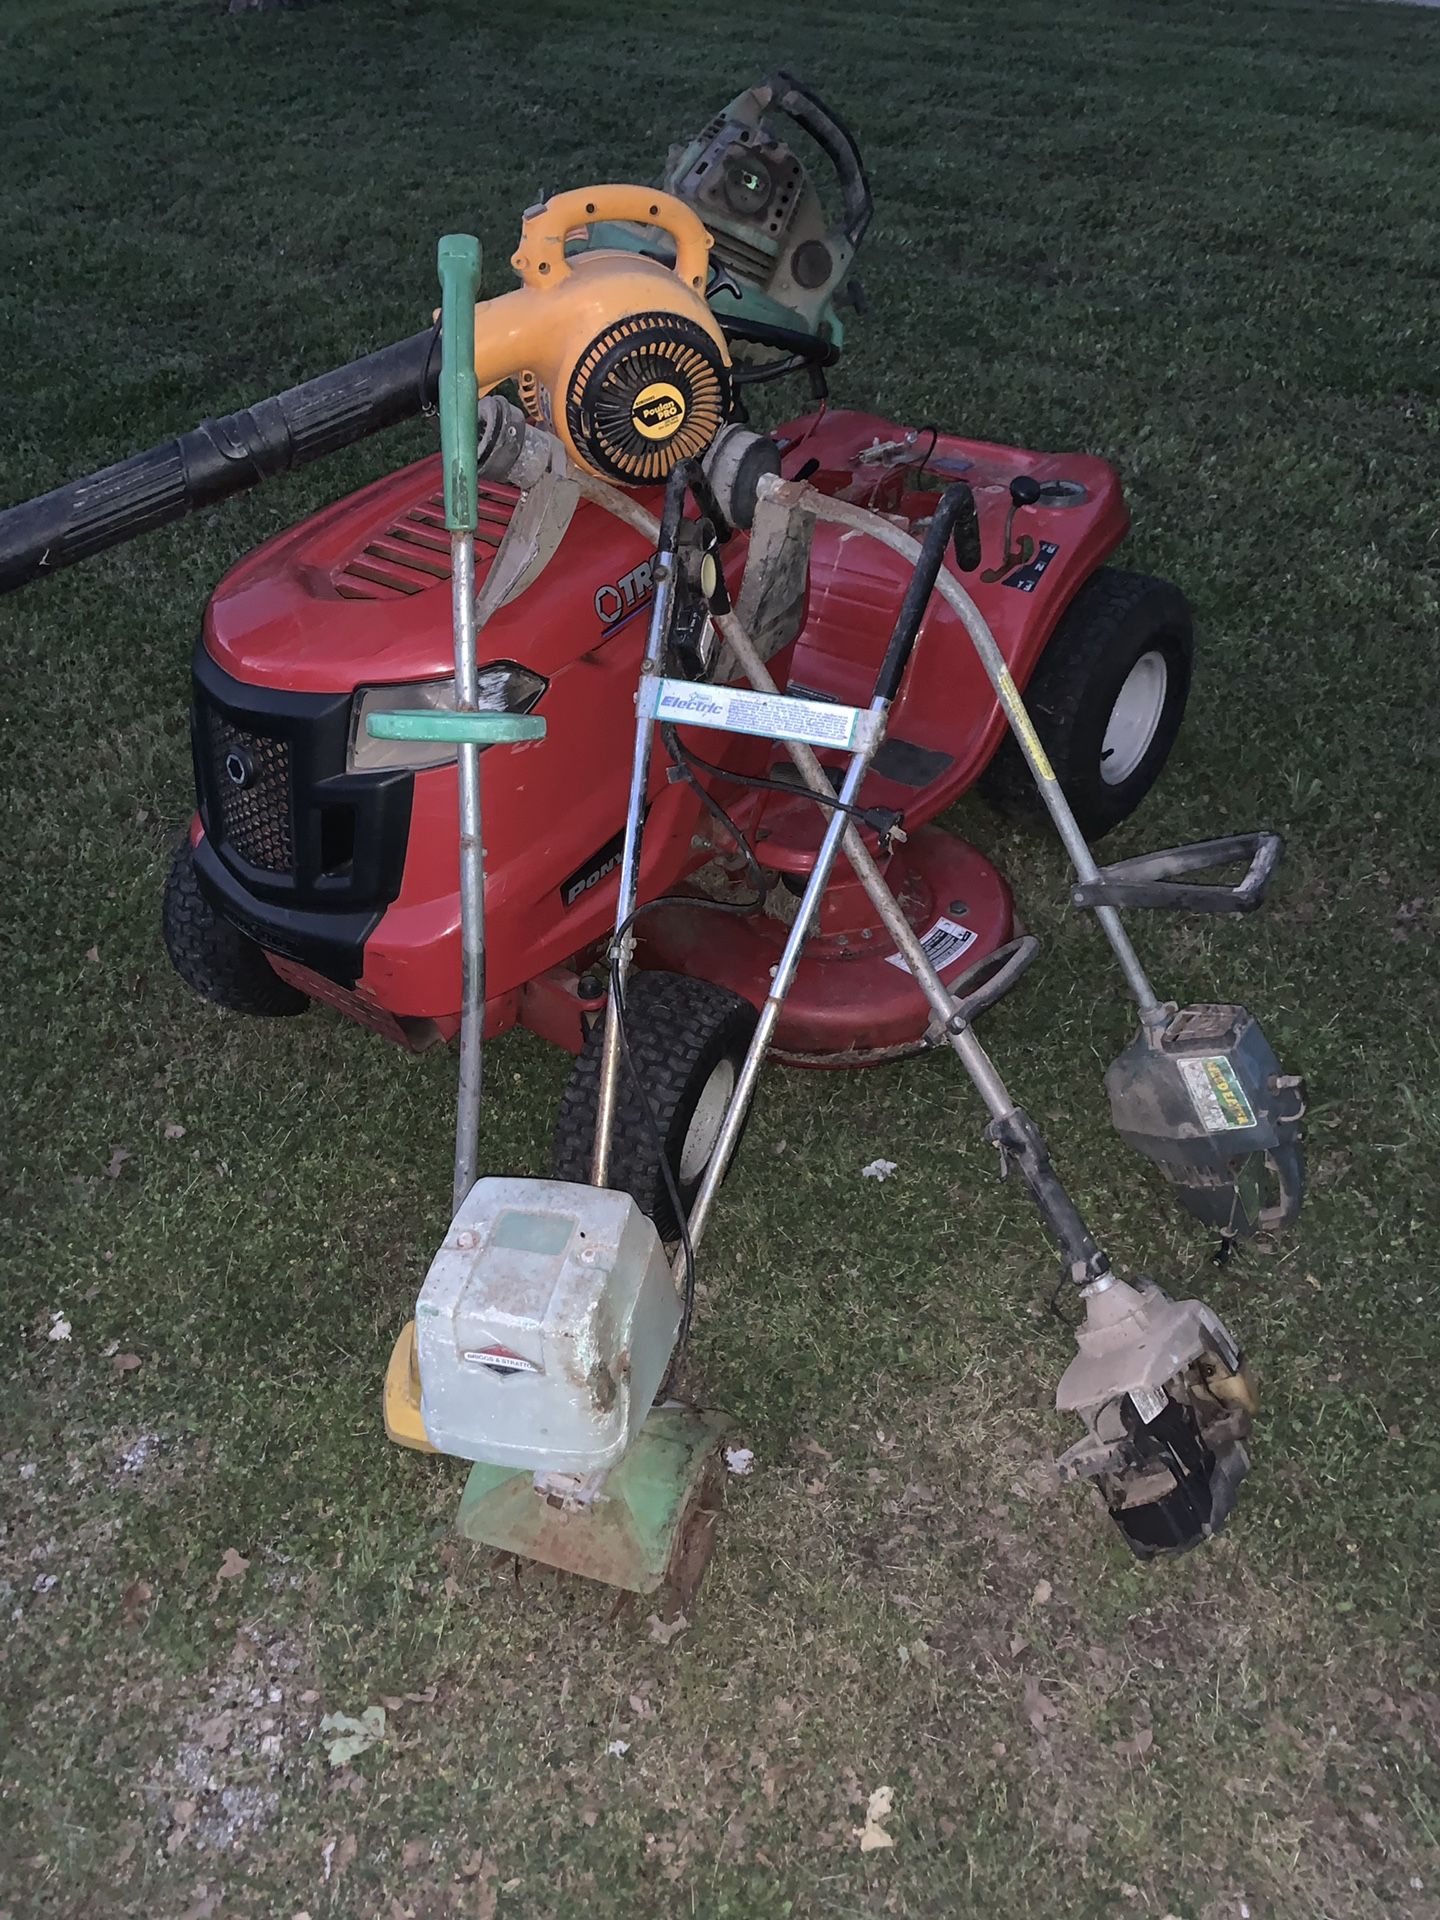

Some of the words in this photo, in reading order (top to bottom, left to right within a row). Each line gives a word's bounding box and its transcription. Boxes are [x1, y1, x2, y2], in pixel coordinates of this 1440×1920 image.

[643, 401, 675, 418] Poulan
[657, 407, 677, 420] PRO
[661, 696, 723, 714] Electric
[502, 1358, 532, 1368] STRATTO
